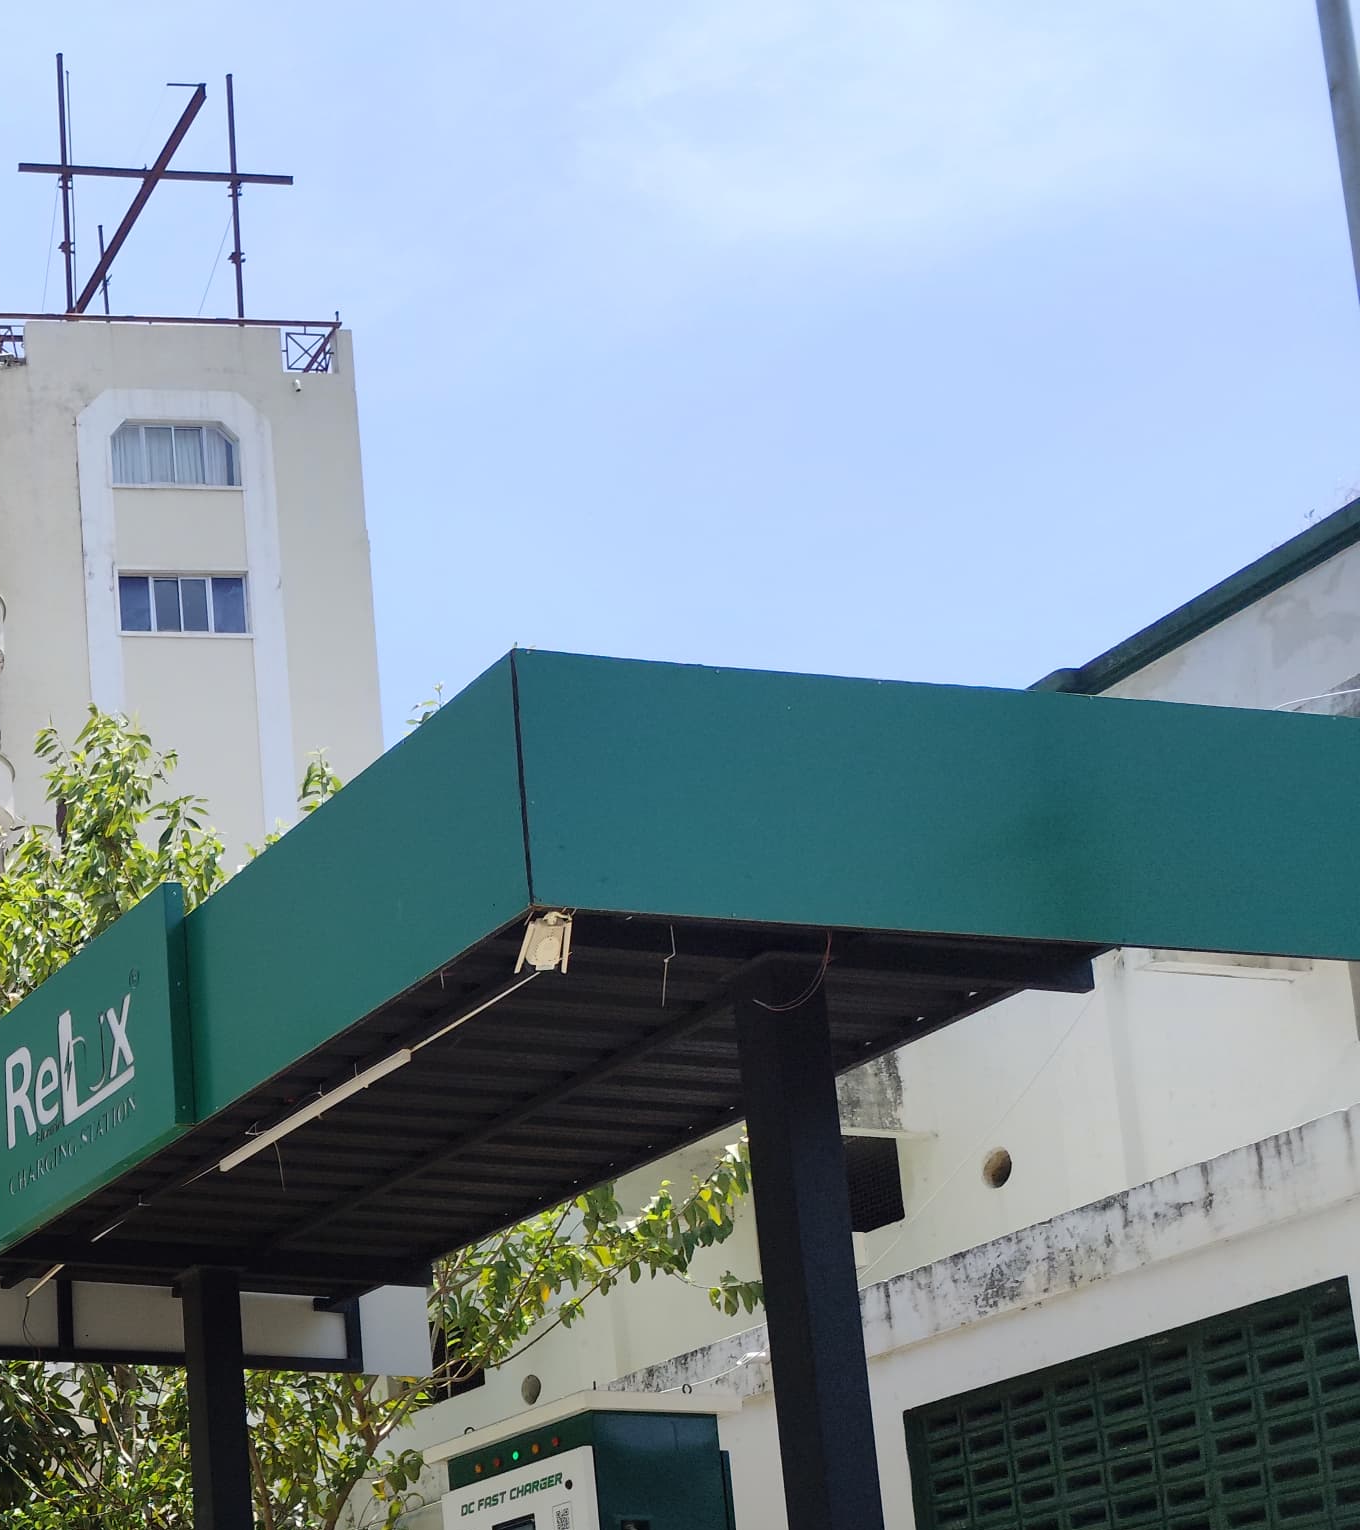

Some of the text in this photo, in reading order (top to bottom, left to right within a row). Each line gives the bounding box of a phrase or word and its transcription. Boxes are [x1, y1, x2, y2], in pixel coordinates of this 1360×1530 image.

[9, 1095, 136, 1195] CHARGING STATION
[461, 1472, 563, 1516] DC FAST CHARGER
